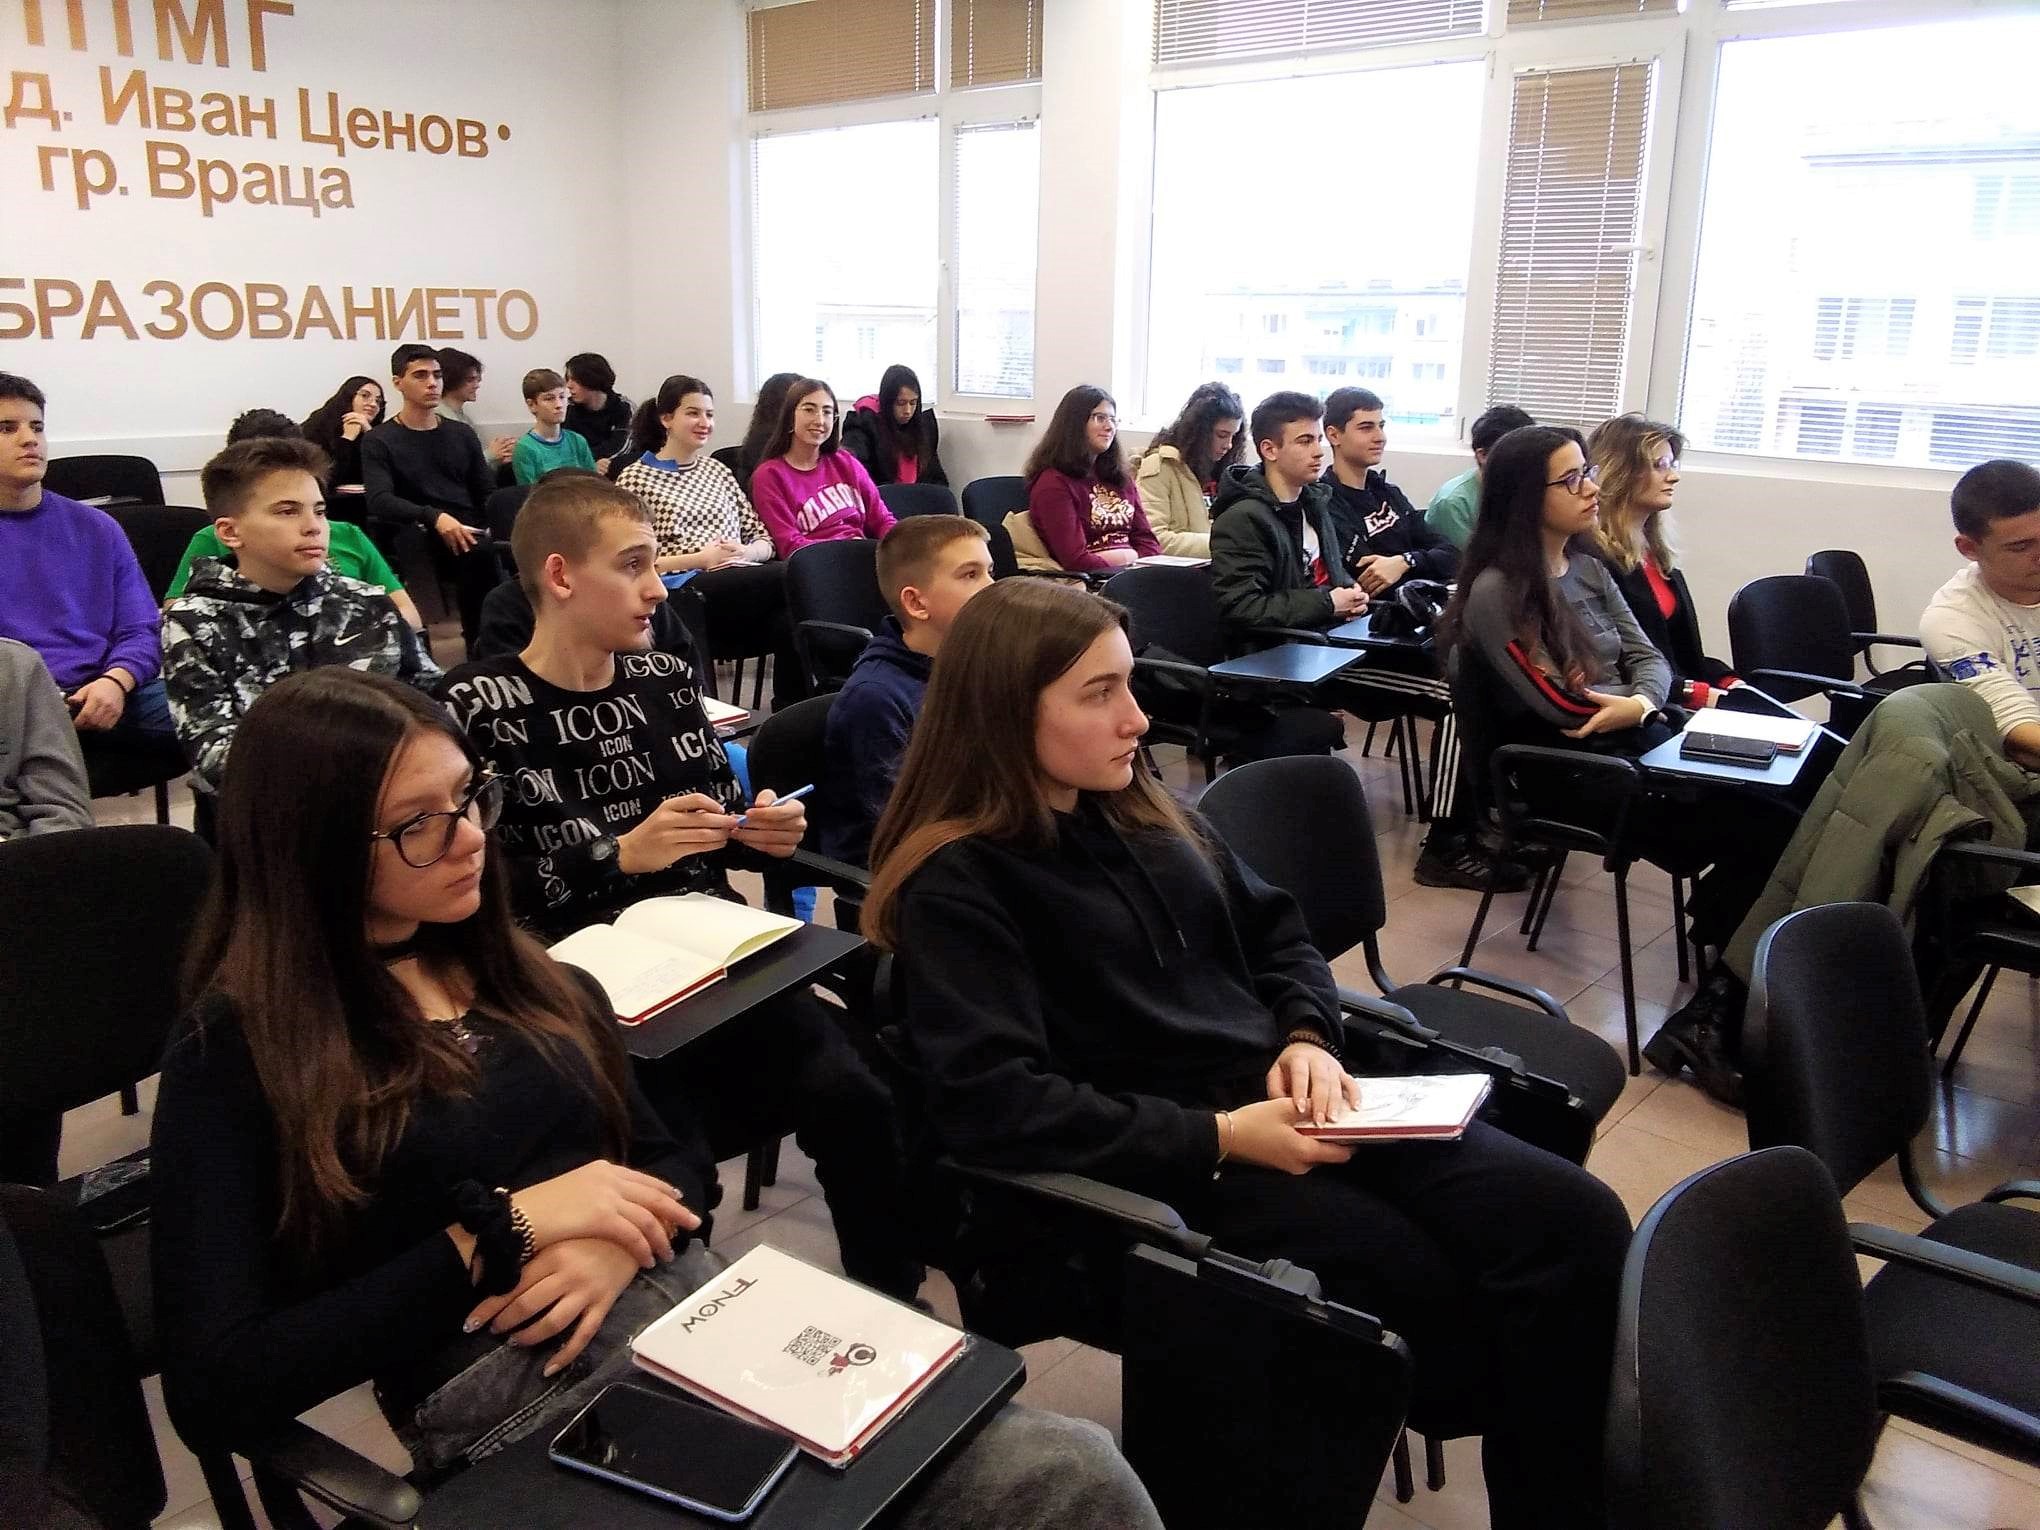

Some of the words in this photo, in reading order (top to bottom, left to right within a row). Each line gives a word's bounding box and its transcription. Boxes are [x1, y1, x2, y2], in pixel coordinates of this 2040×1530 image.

[99, 65, 278, 140] Иван
[37, 144, 129, 211] гр.
[145, 140, 355, 218] Враца
[549, 693, 648, 745] ICON
[598, 733, 634, 758] ICON
[574, 752, 656, 800] ICON
[533, 817, 602, 851] ICON
[602, 797, 642, 823] ICON
